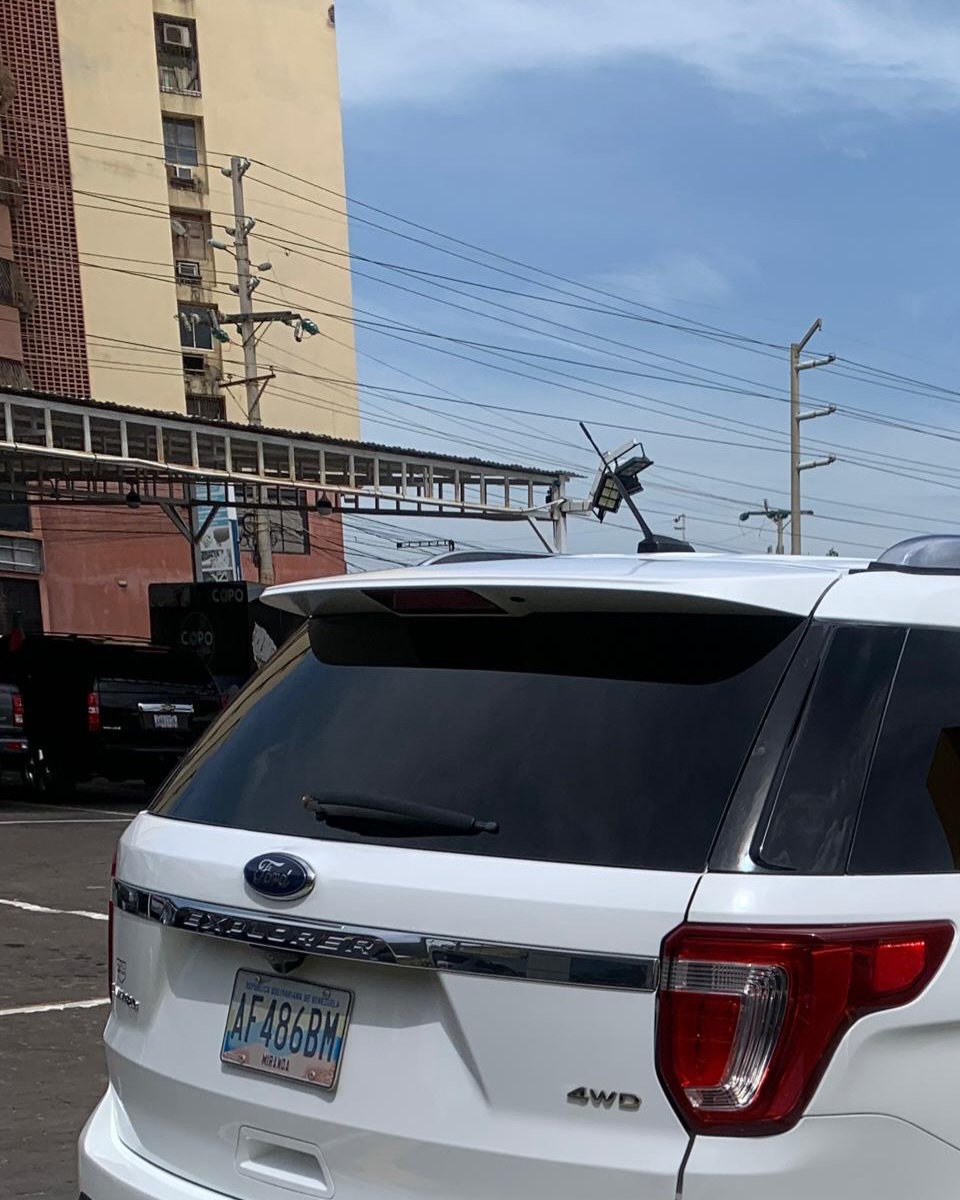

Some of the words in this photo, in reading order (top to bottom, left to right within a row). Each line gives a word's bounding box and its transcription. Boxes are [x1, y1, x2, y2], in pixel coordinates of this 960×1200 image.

[181, 631, 213, 646] COPO
[253, 858, 293, 888] Ford
[184, 912, 376, 955] EXPLORER
[231, 993, 340, 1062] AF486BM
[261, 1053, 290, 1072] MIRANDA
[566, 1086, 642, 1110] 4WD
